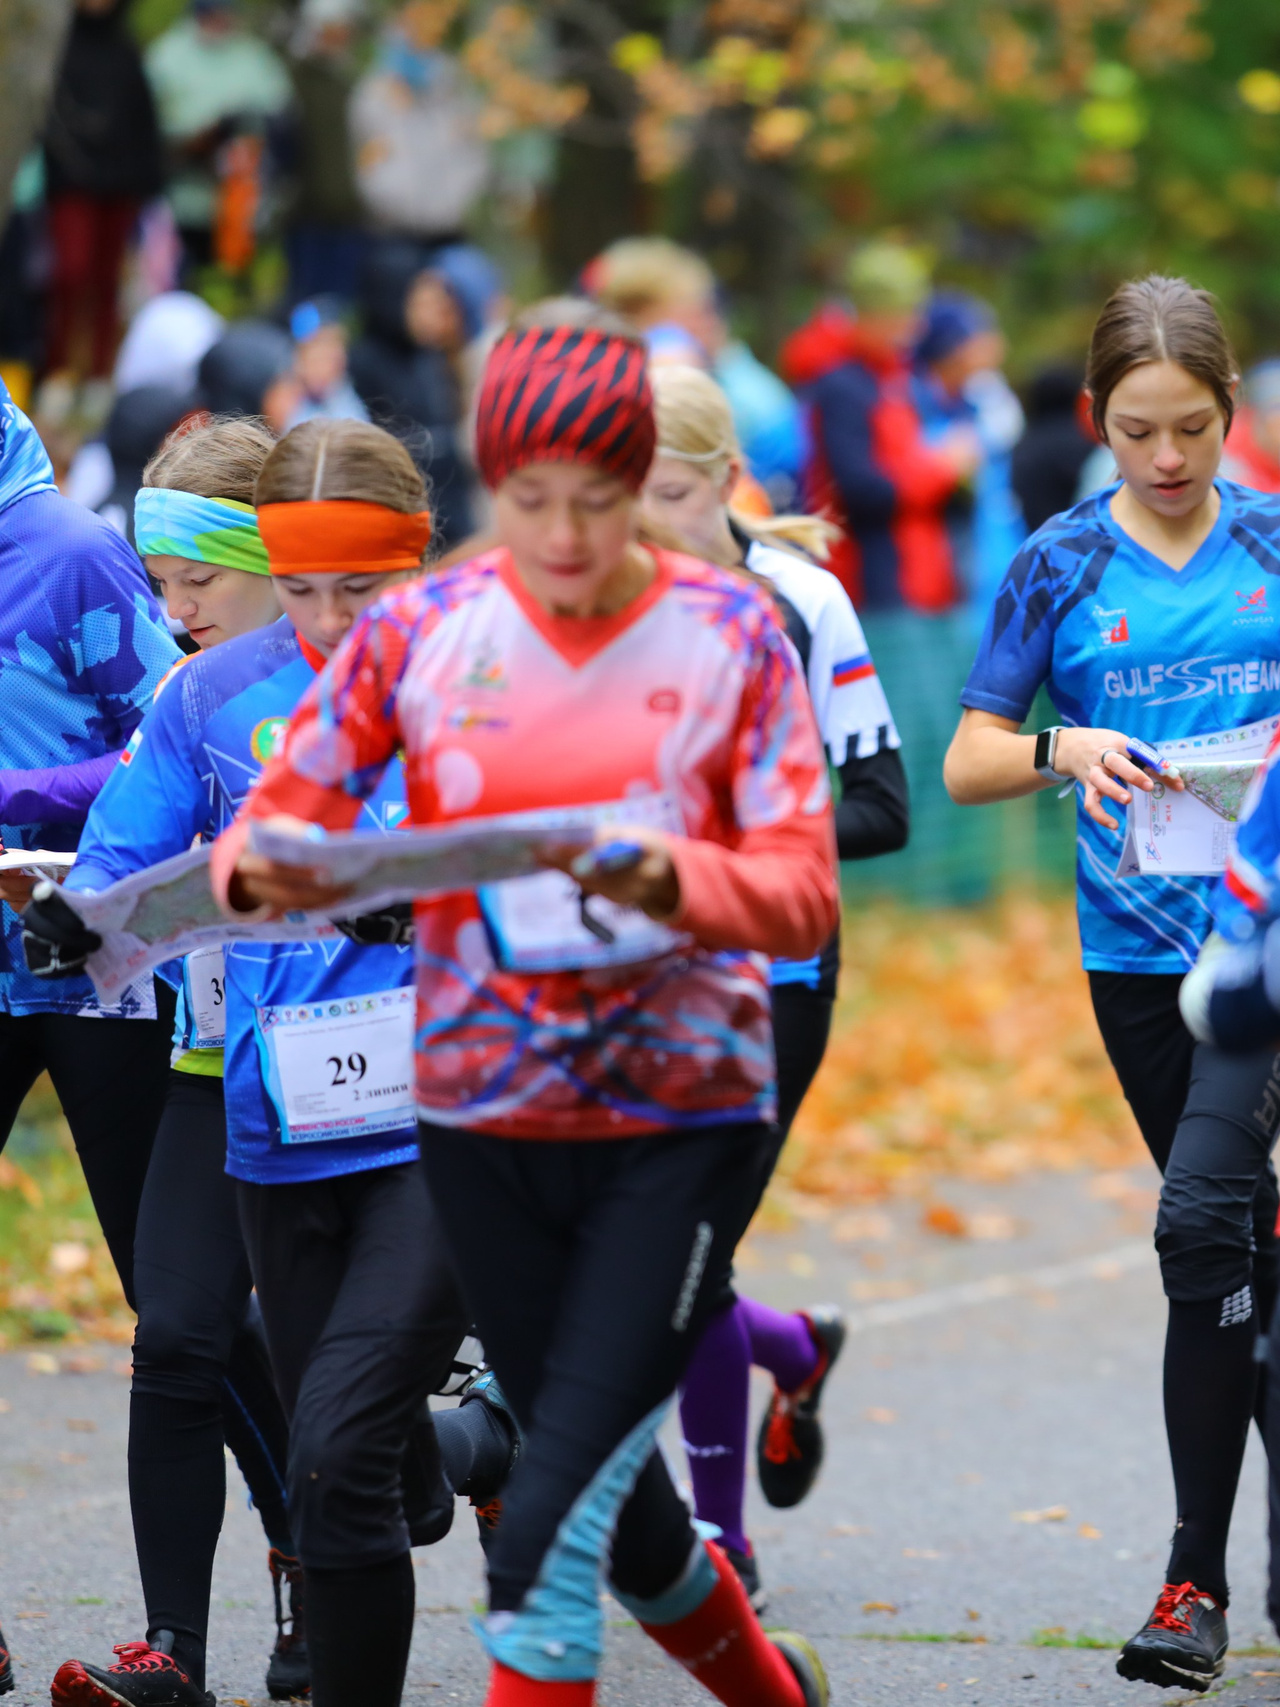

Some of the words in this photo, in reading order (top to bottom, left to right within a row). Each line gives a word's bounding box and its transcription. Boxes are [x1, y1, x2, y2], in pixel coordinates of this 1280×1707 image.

[326, 1052, 367, 1086] 29
[353, 1090, 361, 1101] 2
[365, 1083, 409, 1099] линии
[335, 1116, 366, 1127] РОССИИ
